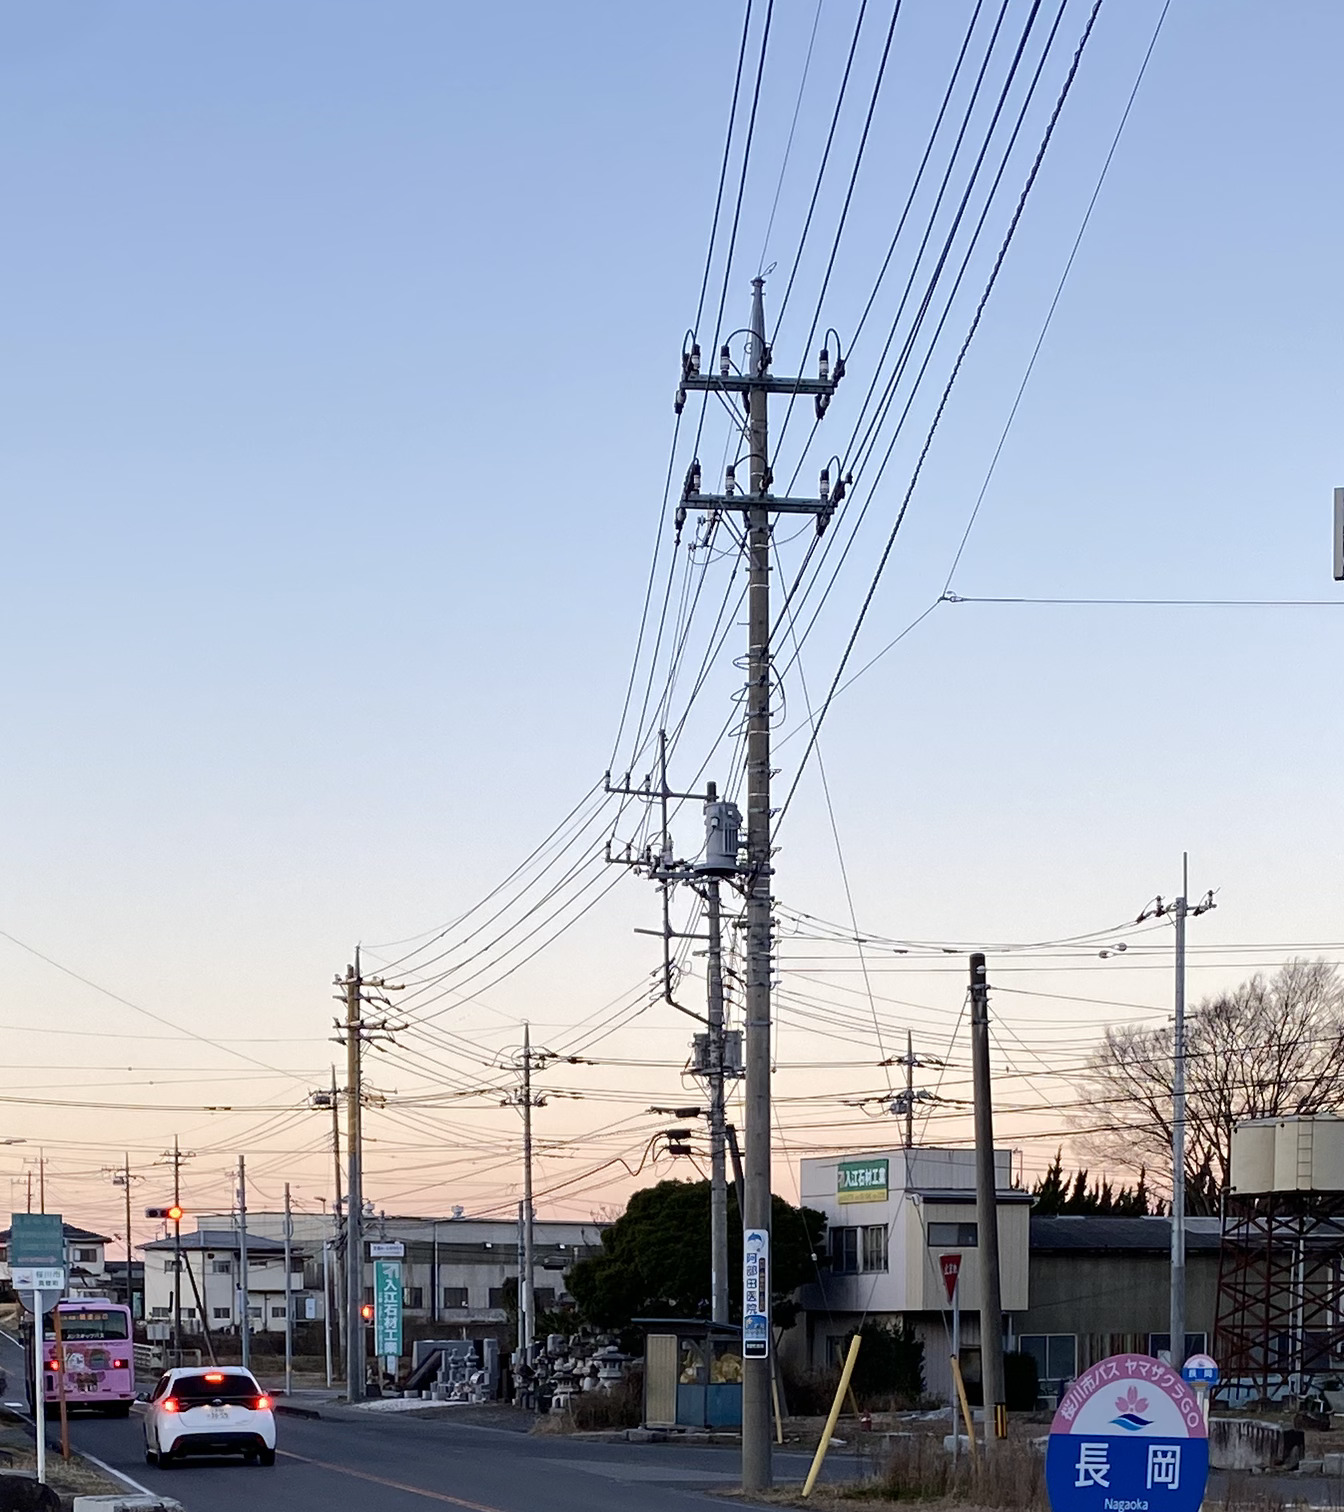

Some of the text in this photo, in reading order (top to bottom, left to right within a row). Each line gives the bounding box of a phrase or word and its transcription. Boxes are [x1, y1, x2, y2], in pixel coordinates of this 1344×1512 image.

[383, 1279, 398, 1354] 入江石材工業
[1060, 1358, 1199, 1428] 桜川市バス ヤマザクラGO
[1104, 1498, 1149, 1512] Nagaoka
